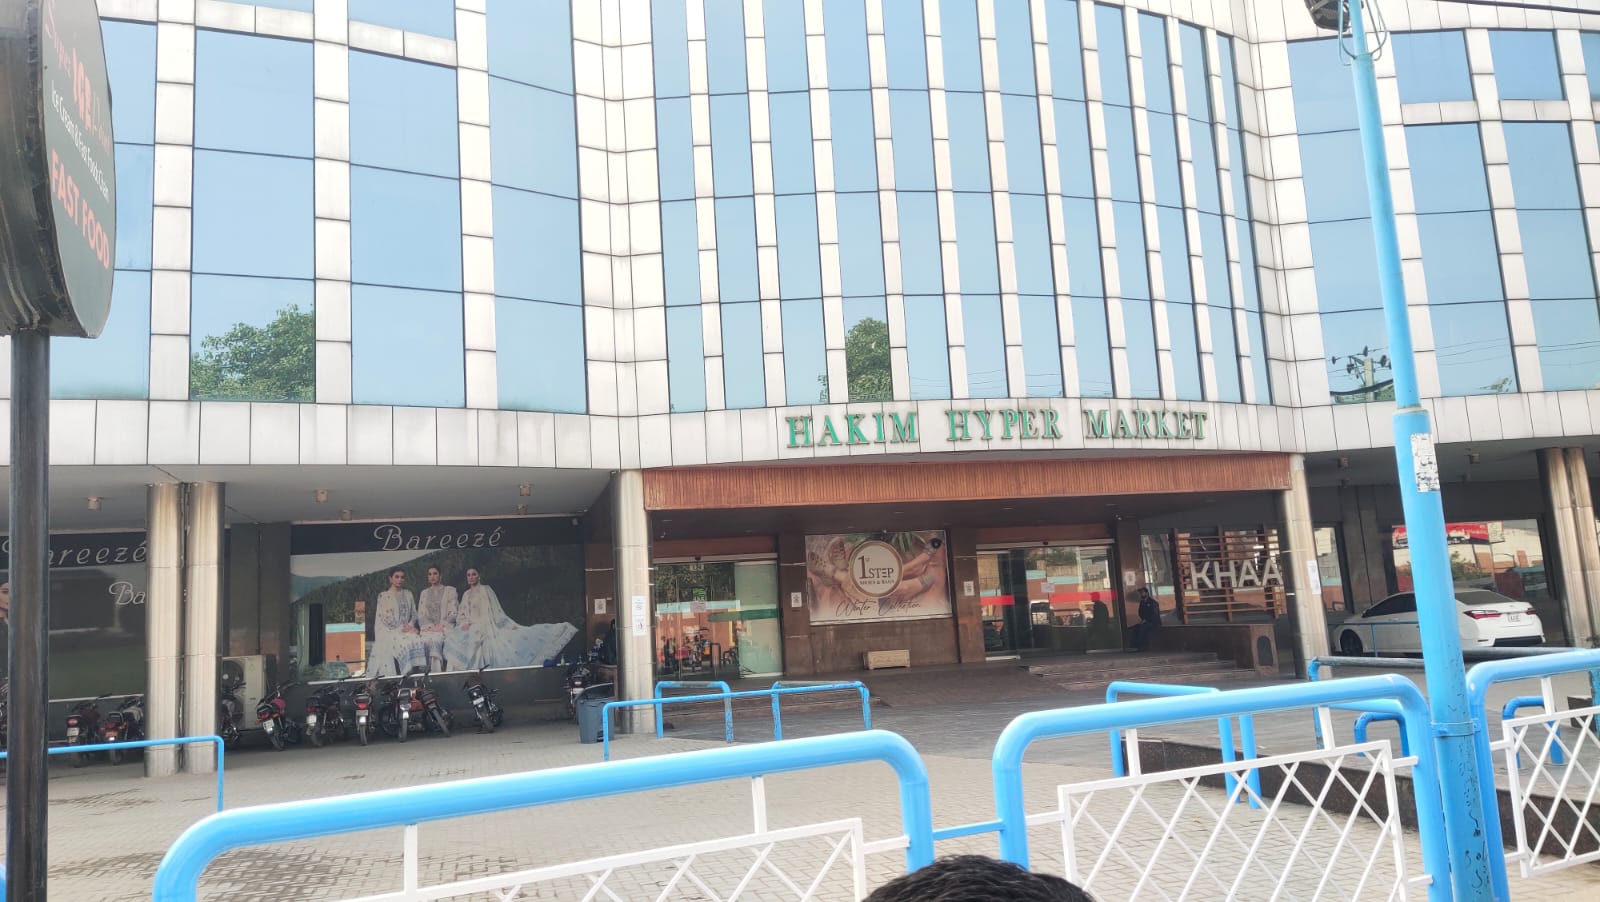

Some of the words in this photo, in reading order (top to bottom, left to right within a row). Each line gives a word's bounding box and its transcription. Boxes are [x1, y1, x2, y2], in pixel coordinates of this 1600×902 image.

[51, 148, 80, 225] FAST
[82, 199, 110, 269] FOOD
[785, 411, 918, 448] HAKIM
[945, 408, 1062, 441] HYPER
[1083, 409, 1207, 440] MARKET
[373, 524, 505, 551] Bareezé
[868, 567, 894, 579] STEP
[1190, 559, 1284, 590] KHAA
[836, 599, 877, 617] Winter
